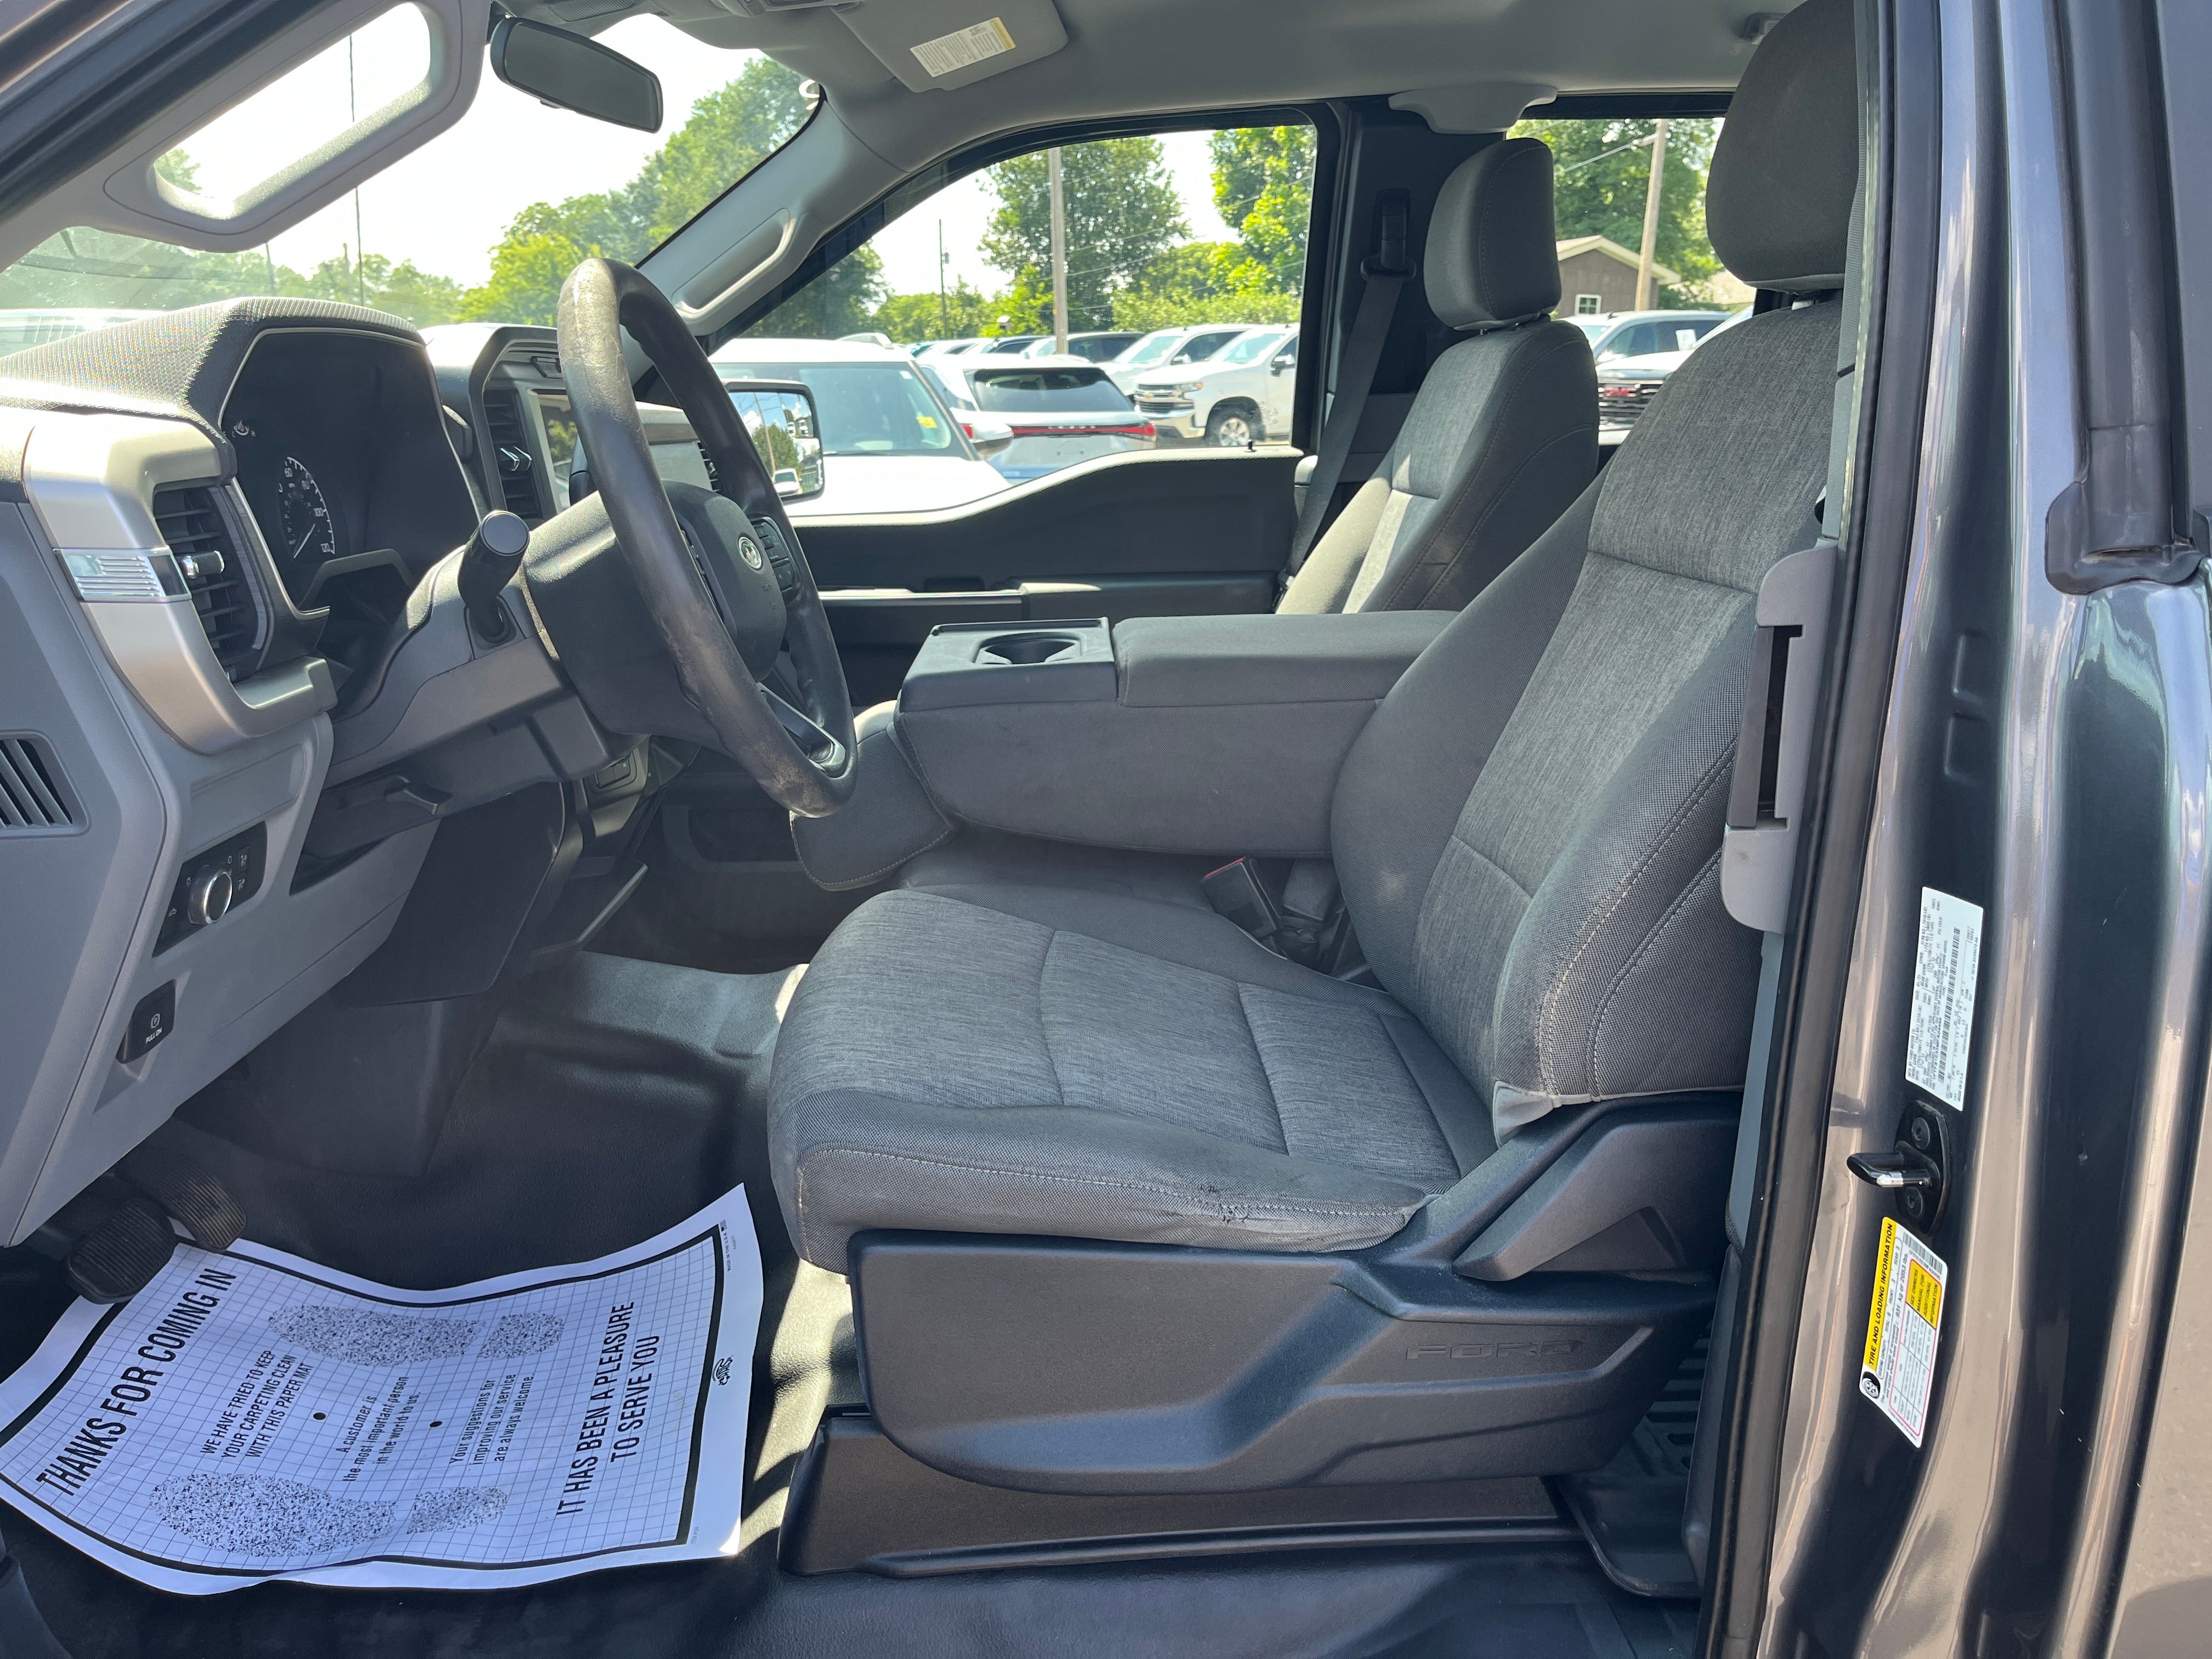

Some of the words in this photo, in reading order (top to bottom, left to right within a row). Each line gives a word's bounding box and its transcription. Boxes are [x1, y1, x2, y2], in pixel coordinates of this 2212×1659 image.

[284, 467, 293, 478] 60
[313, 507, 324, 517] 100
[156, 1027, 162, 1036] ON
[1875, 1284, 1884, 1325] LOADING
[1880, 1222, 1893, 1285] INFORMATION
[1897, 1291, 1903, 1302] kg
[1899, 1284, 1903, 1292] or
[1923, 1280, 1931, 1317] ADDITIONAL
[1929, 1283, 1938, 1324] INFORMATION
[594, 1301, 635, 1387] PLEASURE
[631, 1335, 660, 1372] YOU
[1406, 1340, 1583, 1360] FORD
[254, 1350, 275, 1369] KEEP
[36, 1418, 127, 1496] THANKS
[100, 1367, 164, 1416] FOR
[138, 1292, 220, 1362] COMING
[195, 1268, 237, 1291] IN
[246, 1369, 263, 1380] TO
[228, 1383, 255, 1408] TRIED
[388, 1376, 409, 1403] person
[512, 1373, 535, 1413] welcome.
[590, 1387, 615, 1402] A
[618, 1373, 653, 1433] SERVE
[221, 1433, 249, 1458] YOUR
[240, 1379, 281, 1430] CARPETING
[271, 1355, 297, 1378] CLEAN
[245, 1433, 272, 1458] WITH
[262, 1409, 285, 1431] THIS
[275, 1380, 303, 1408] PAPER
[294, 1363, 313, 1379] MAT
[343, 1405, 371, 1445] customer
[362, 1396, 377, 1404] is
[469, 1421, 501, 1465] improving
[490, 1406, 504, 1419] our
[497, 1374, 516, 1404] service
[211, 1410, 238, 1438] HAVE
[363, 1404, 395, 1443] important
[379, 1441, 397, 1454] the
[389, 1416, 409, 1439] world
[407, 1392, 421, 1404] us.
[449, 1443, 469, 1464] Your
[462, 1392, 490, 1441] suggestions
[480, 1380, 496, 1391] for
[499, 1415, 521, 1443] always
[576, 1405, 611, 1453] BEEN
[200, 1439, 221, 1454] WE
[354, 1446, 374, 1465] most
[494, 1446, 508, 1462] are
[610, 1436, 640, 1463] TO
[342, 1468, 361, 1481] the
[563, 1455, 599, 1494] HAS
[556, 1500, 586, 1515] IT
